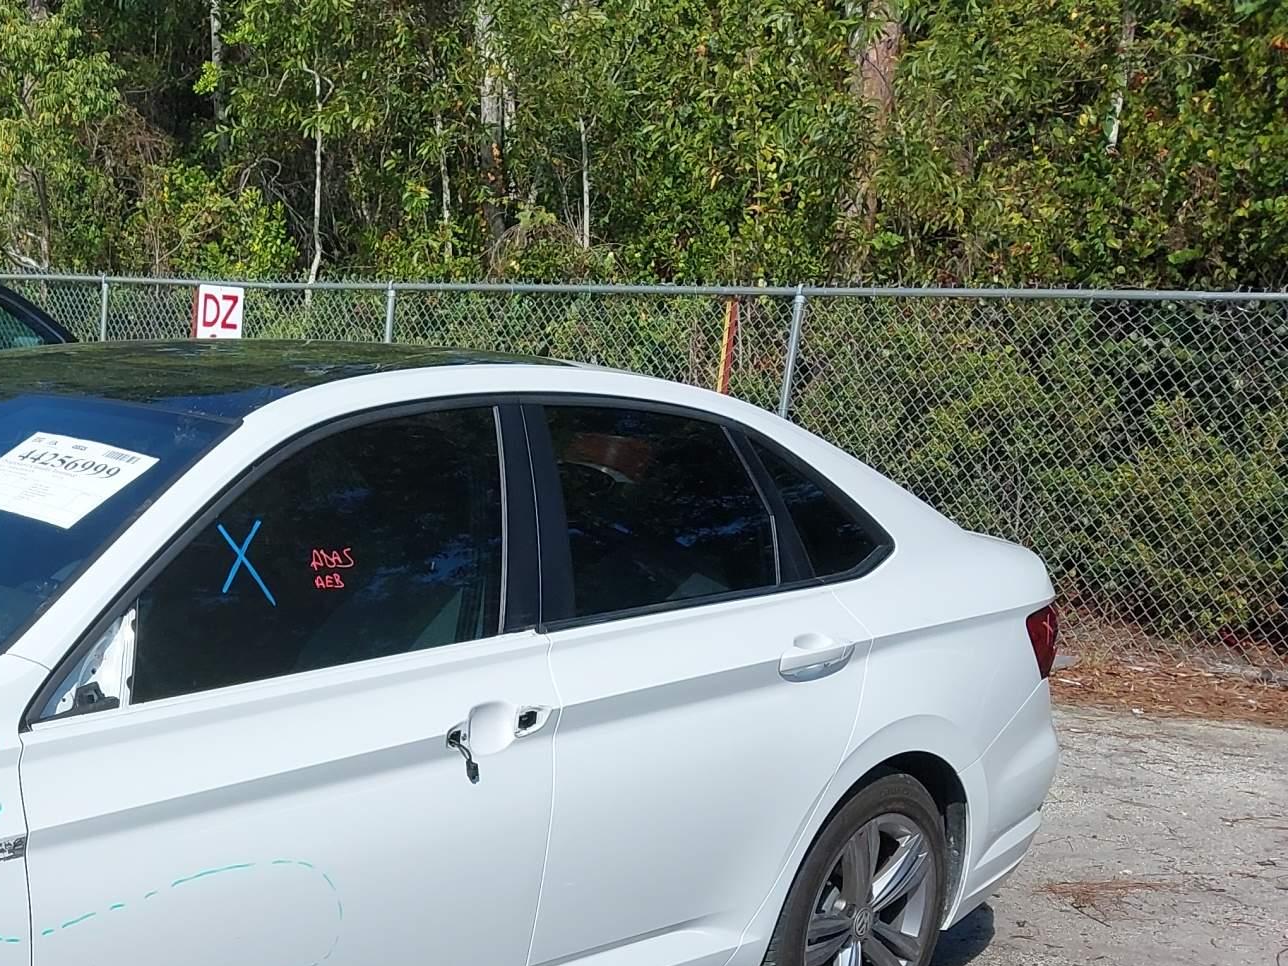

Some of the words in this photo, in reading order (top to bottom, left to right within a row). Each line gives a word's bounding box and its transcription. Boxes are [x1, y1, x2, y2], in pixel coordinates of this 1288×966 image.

[202, 292, 239, 330] DZ
[18, 448, 122, 479] 44256999
[314, 573, 345, 589] AEB
